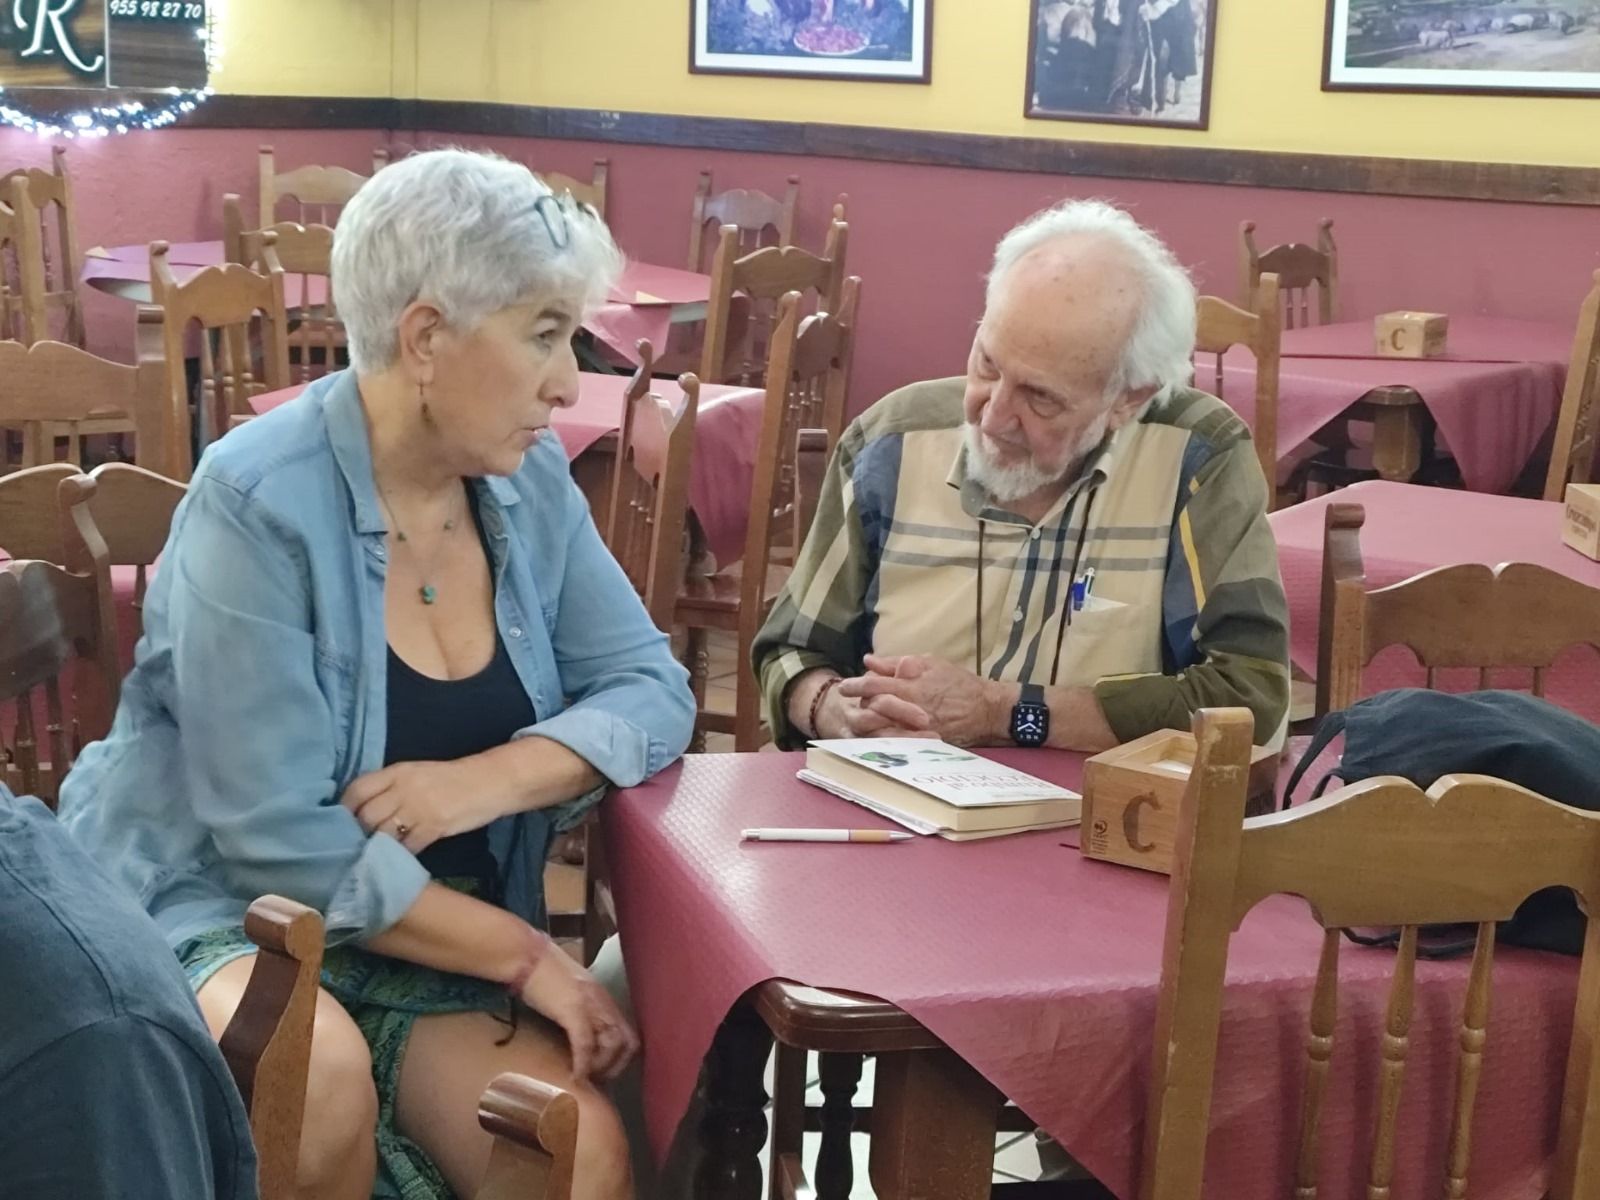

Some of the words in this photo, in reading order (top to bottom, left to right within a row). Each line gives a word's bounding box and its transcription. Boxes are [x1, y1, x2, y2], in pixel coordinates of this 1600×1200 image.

[110, 0, 138, 15] 955
[141, 1, 160, 17] 98
[161, 2, 181, 18] 27
[184, 3, 202, 18] 70
[1392, 329, 1407, 351] C
[1123, 789, 1162, 853] C
